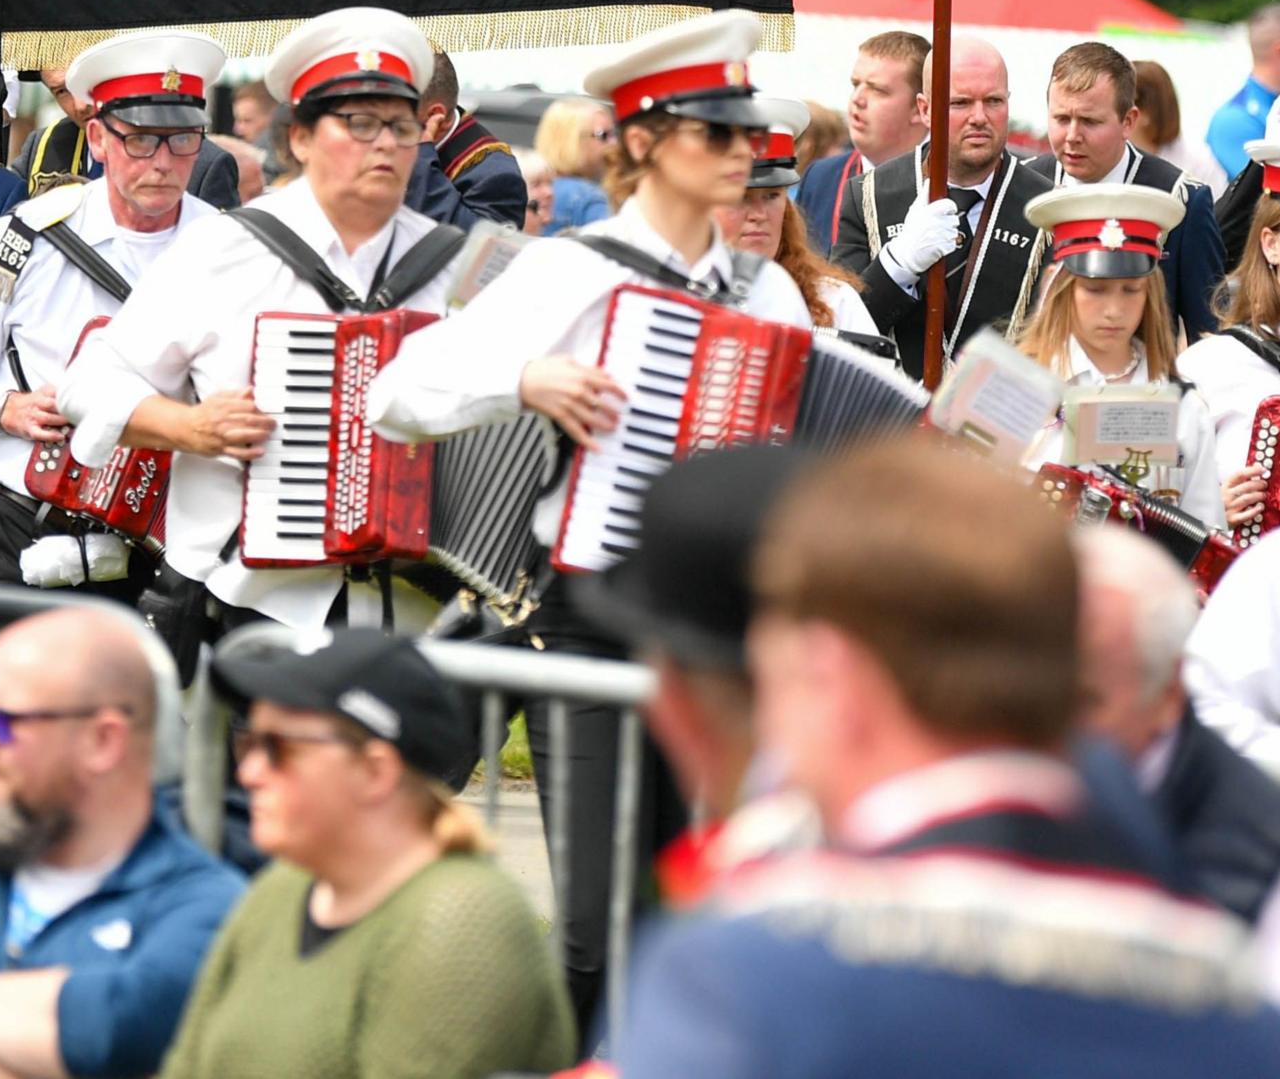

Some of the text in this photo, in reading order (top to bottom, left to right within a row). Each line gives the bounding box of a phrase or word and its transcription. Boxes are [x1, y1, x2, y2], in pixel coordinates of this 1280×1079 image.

[1, 228, 32, 255] RBP
[994, 228, 1031, 249] 1167
[124, 457, 157, 514] Paolo
